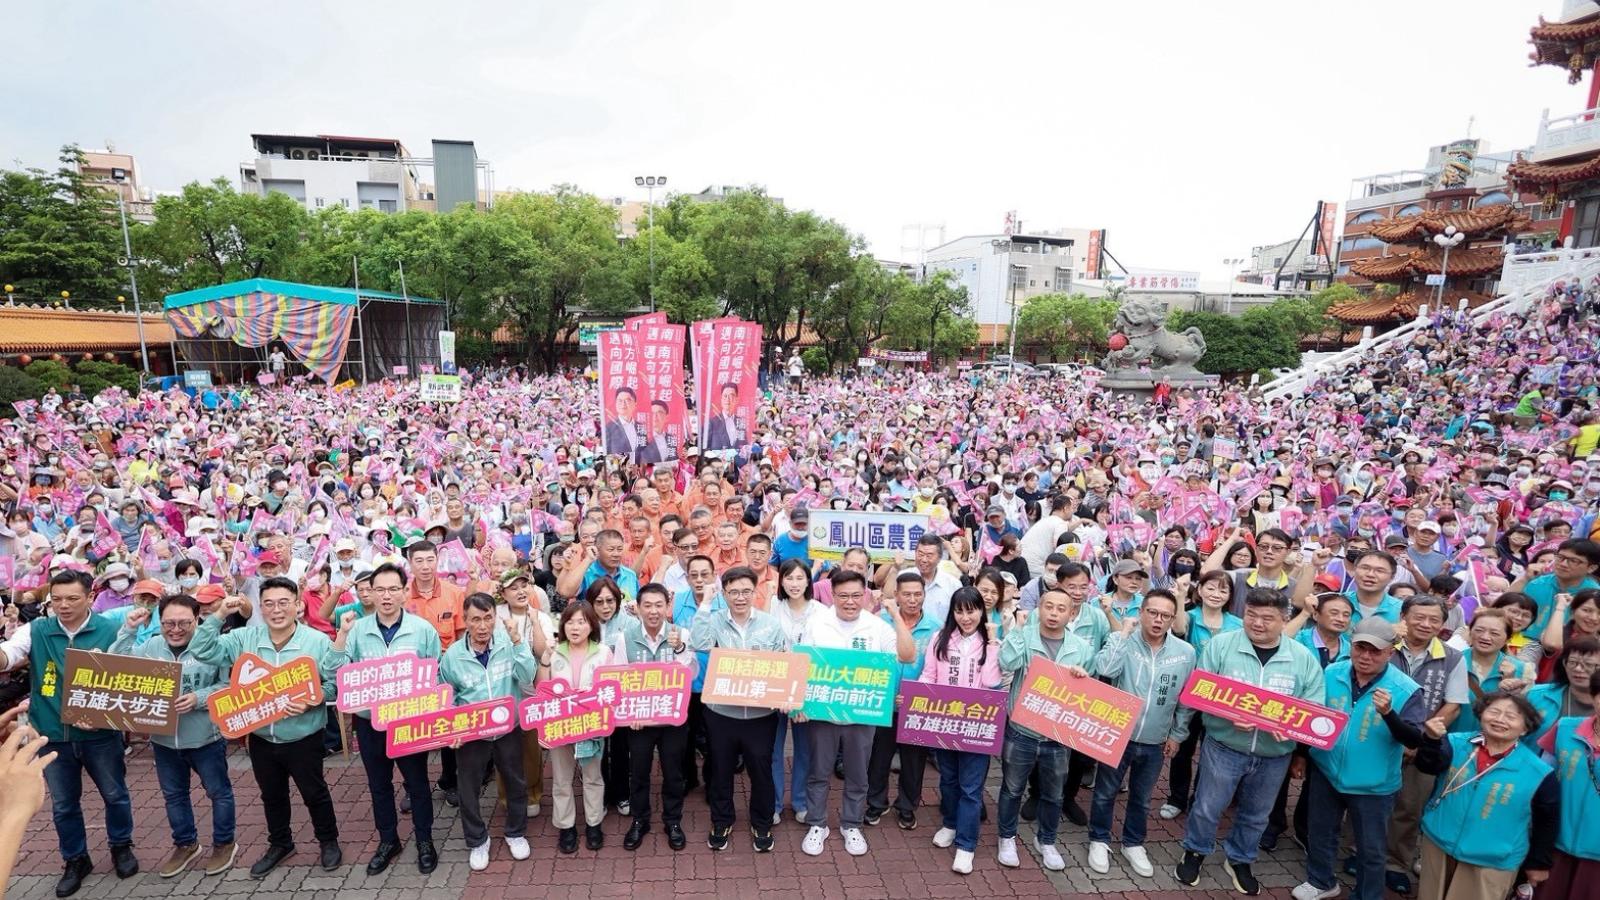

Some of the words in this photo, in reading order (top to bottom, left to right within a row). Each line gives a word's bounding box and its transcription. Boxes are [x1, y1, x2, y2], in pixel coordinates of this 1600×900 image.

[658, 345, 672, 401] 南方崛起
[717, 326, 732, 385] 邁向國際
[732, 326, 746, 384] 南方崛起
[829, 521, 925, 550] 鳳山區農會
[72, 668, 176, 697] 鳳山挺瑞隆
[343, 659, 413, 685] 咱的高雄
[716, 656, 789, 679] 團結勝選
[67, 689, 170, 718] 高雄大步走
[214, 663, 313, 717] 鳳山大團結
[343, 679, 413, 707] 咱的選擇
[525, 685, 616, 724] 高雄下一棒
[1031, 674, 1133, 730] 鳳山大團結
[1190, 678, 1312, 729] 鳳山全壘打
[393, 708, 490, 746] 鳳山全壘打
[543, 707, 609, 743] 賴瑞隆!
[903, 713, 998, 740] 高雄挺瑞隆
[1021, 692, 1121, 747] 瑞隆向前行
